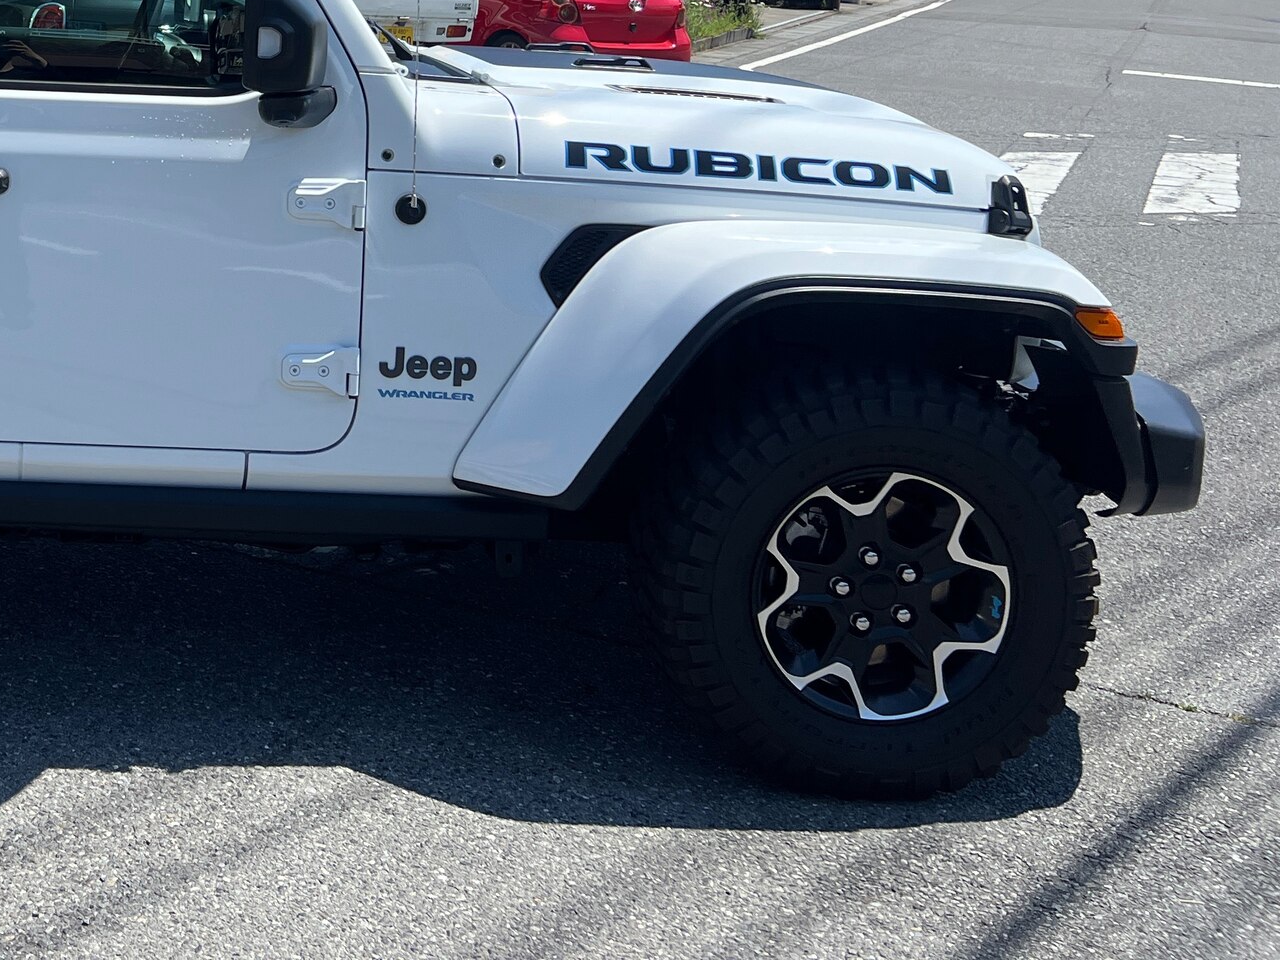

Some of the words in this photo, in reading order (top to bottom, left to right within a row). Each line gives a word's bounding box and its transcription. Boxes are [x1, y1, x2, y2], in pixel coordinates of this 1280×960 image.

[564, 140, 954, 195] RUBICON
[378, 346, 477, 387] Jeep
[377, 388, 475, 401] WRANGLER
